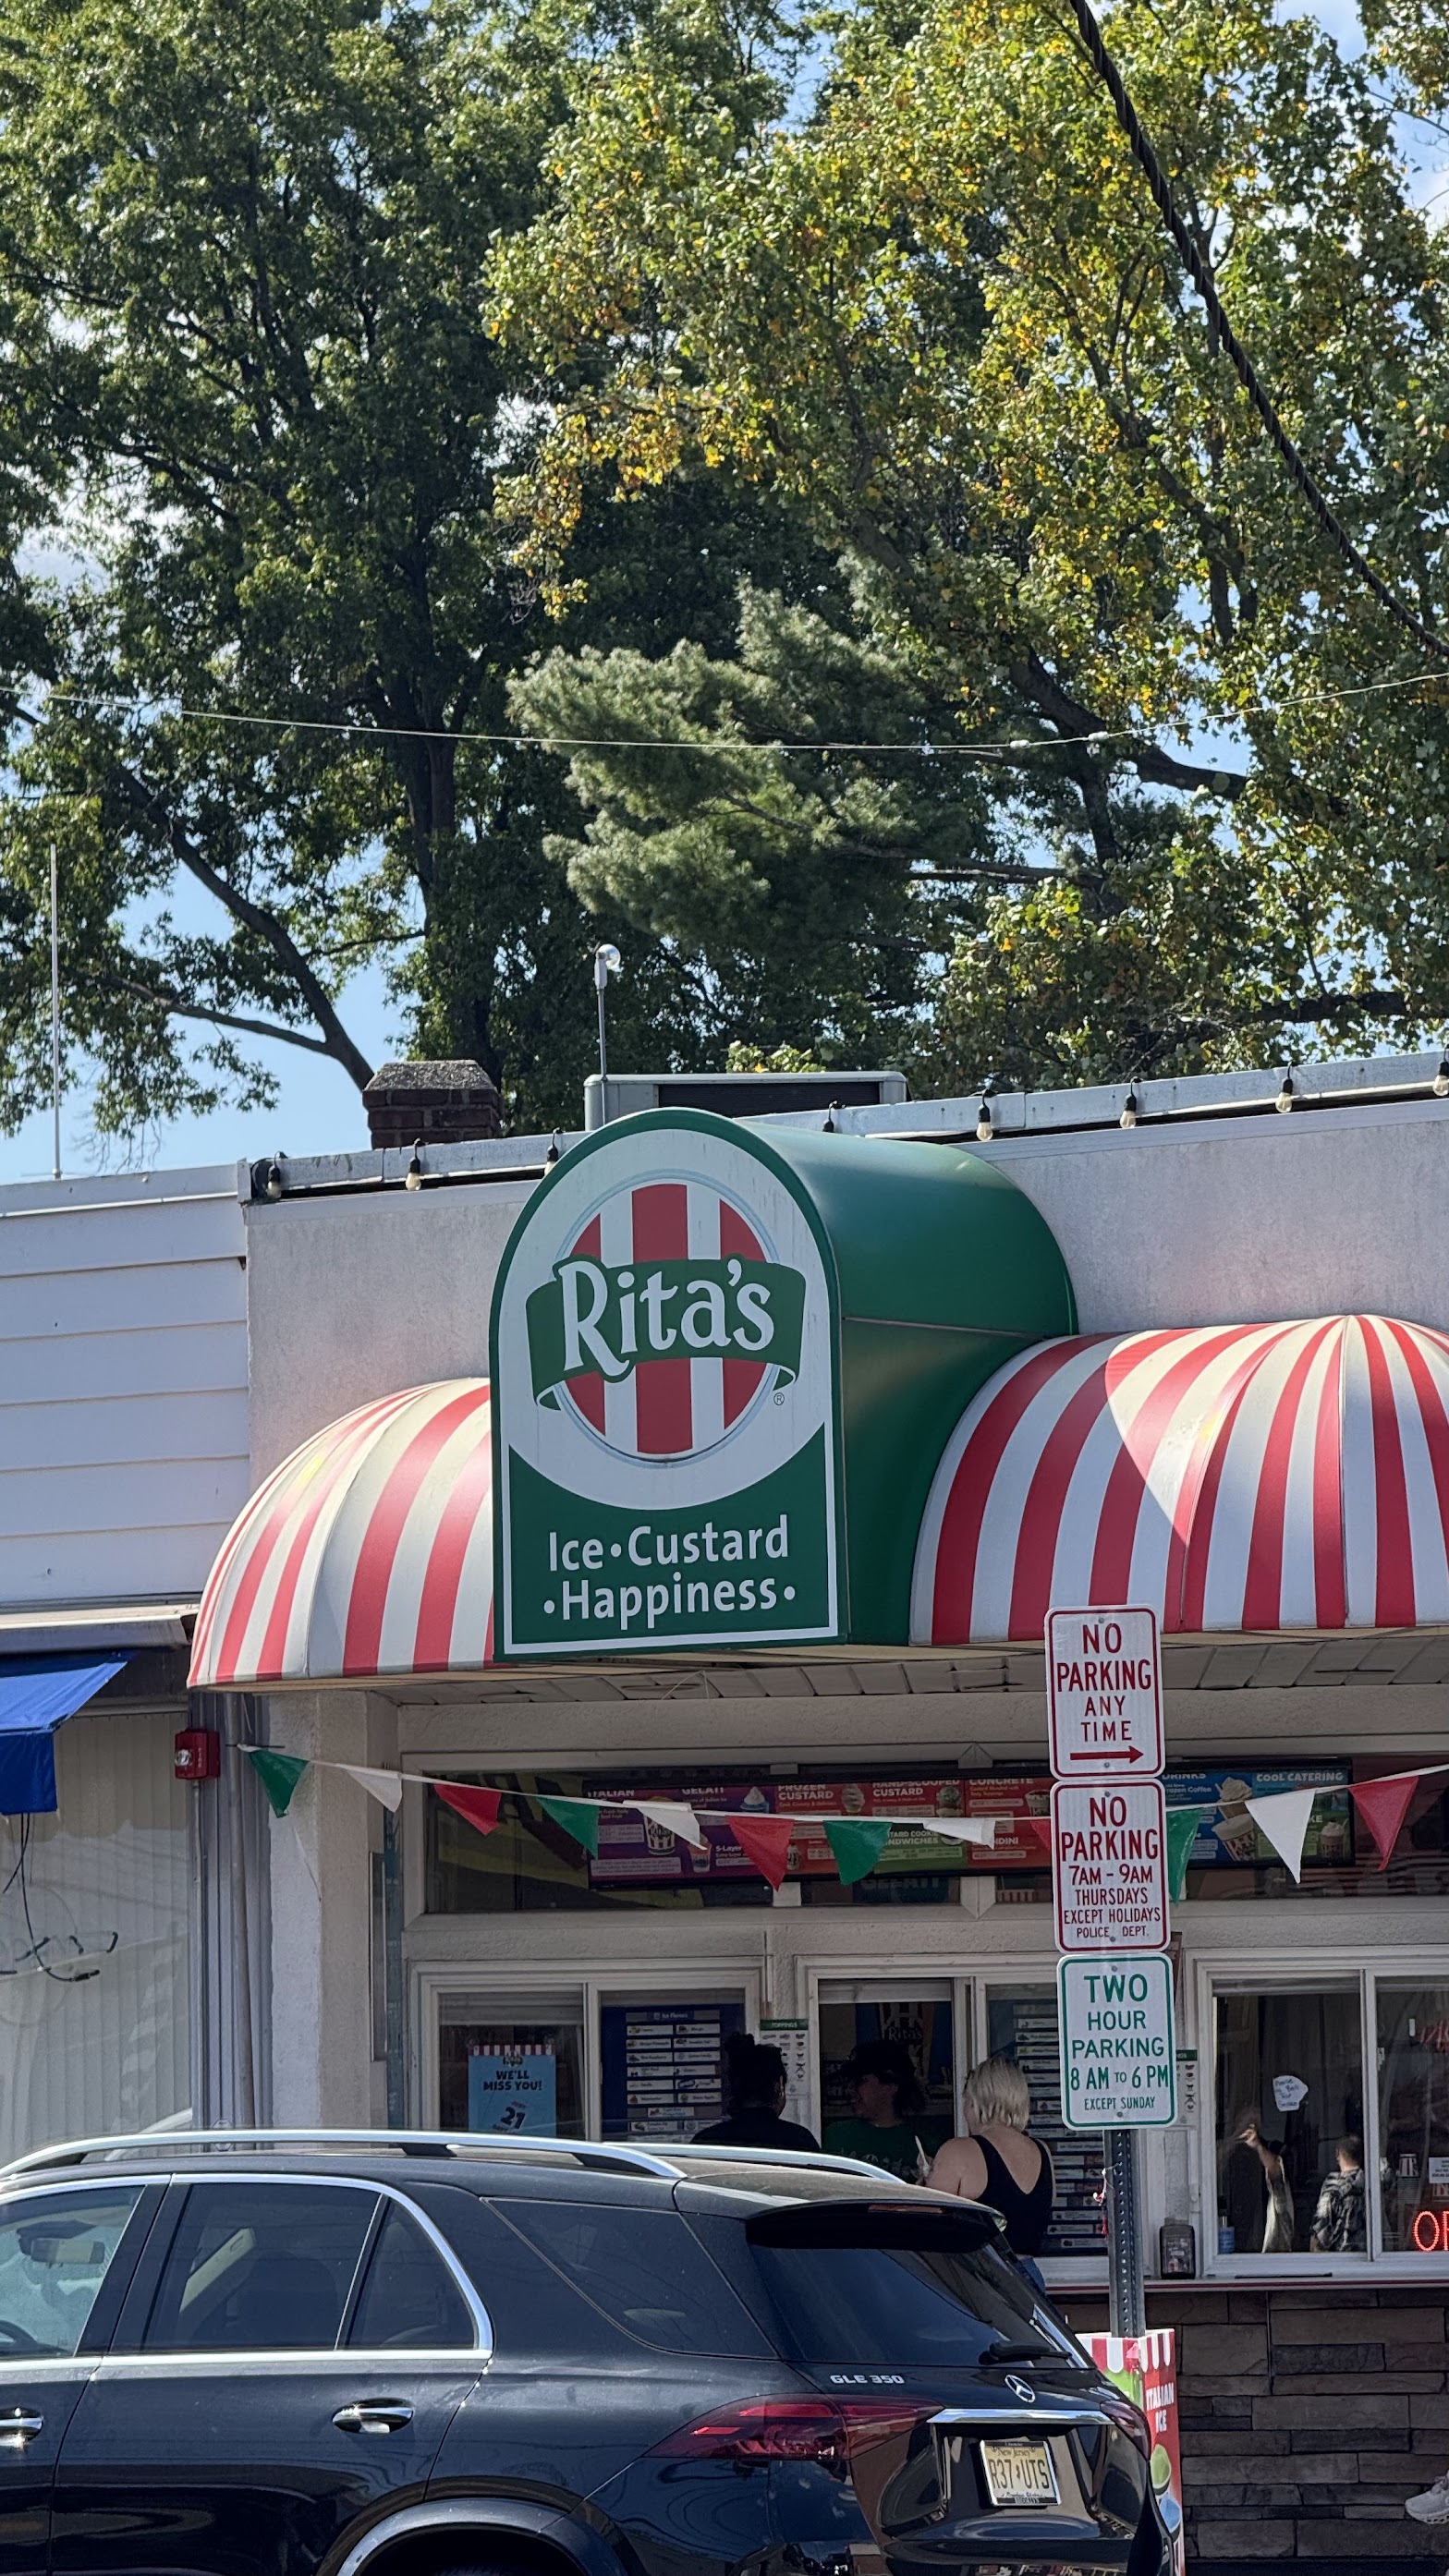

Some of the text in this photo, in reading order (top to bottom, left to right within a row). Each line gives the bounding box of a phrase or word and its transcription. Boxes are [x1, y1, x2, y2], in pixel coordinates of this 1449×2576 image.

[557, 1258, 774, 1377] Rita's
[1082, 1622, 1122, 1654] NO
[1057, 1659, 1151, 1693] PARKING
[1084, 1695, 1126, 1717] ANY
[1080, 1720, 1132, 1743] TIME
[1256, 1771, 1345, 1782] COOL CATERING
[778, 1791, 834, 1801] CUSTARD
[872, 1787, 924, 1797] CUSTARD
[1089, 1796, 1126, 1828] NO
[884, 1837, 938, 1845] NDWICHES
[1061, 1829, 1158, 1862] PARKING
[1069, 1865, 1102, 1886] 7AM
[1119, 1864, 1153, 1884] 9AM
[1075, 1888, 1149, 1906] THURSDAYS
[1064, 1907, 1161, 1925] EXCEPT HOLIDAYS
[1077, 1926, 1110, 1938] POLICE
[1083, 1974, 1149, 2003] TWO
[1088, 2010, 1147, 2031] HOUR
[1072, 2036, 1164, 2060] PARKING
[483, 2080, 542, 2091] MISS YOU!
[495, 2070, 530, 2080] WE'LL
[1114, 2072, 1127, 2084] TO
[1084, 2096, 1155, 2110] EXCEPT SUNDAY
[500, 2107, 526, 2129] 21
[830, 2375, 905, 2384] GLE 350
[1146, 2382, 1175, 2411] ITALIAN
[1155, 2410, 1167, 2433] ICE
